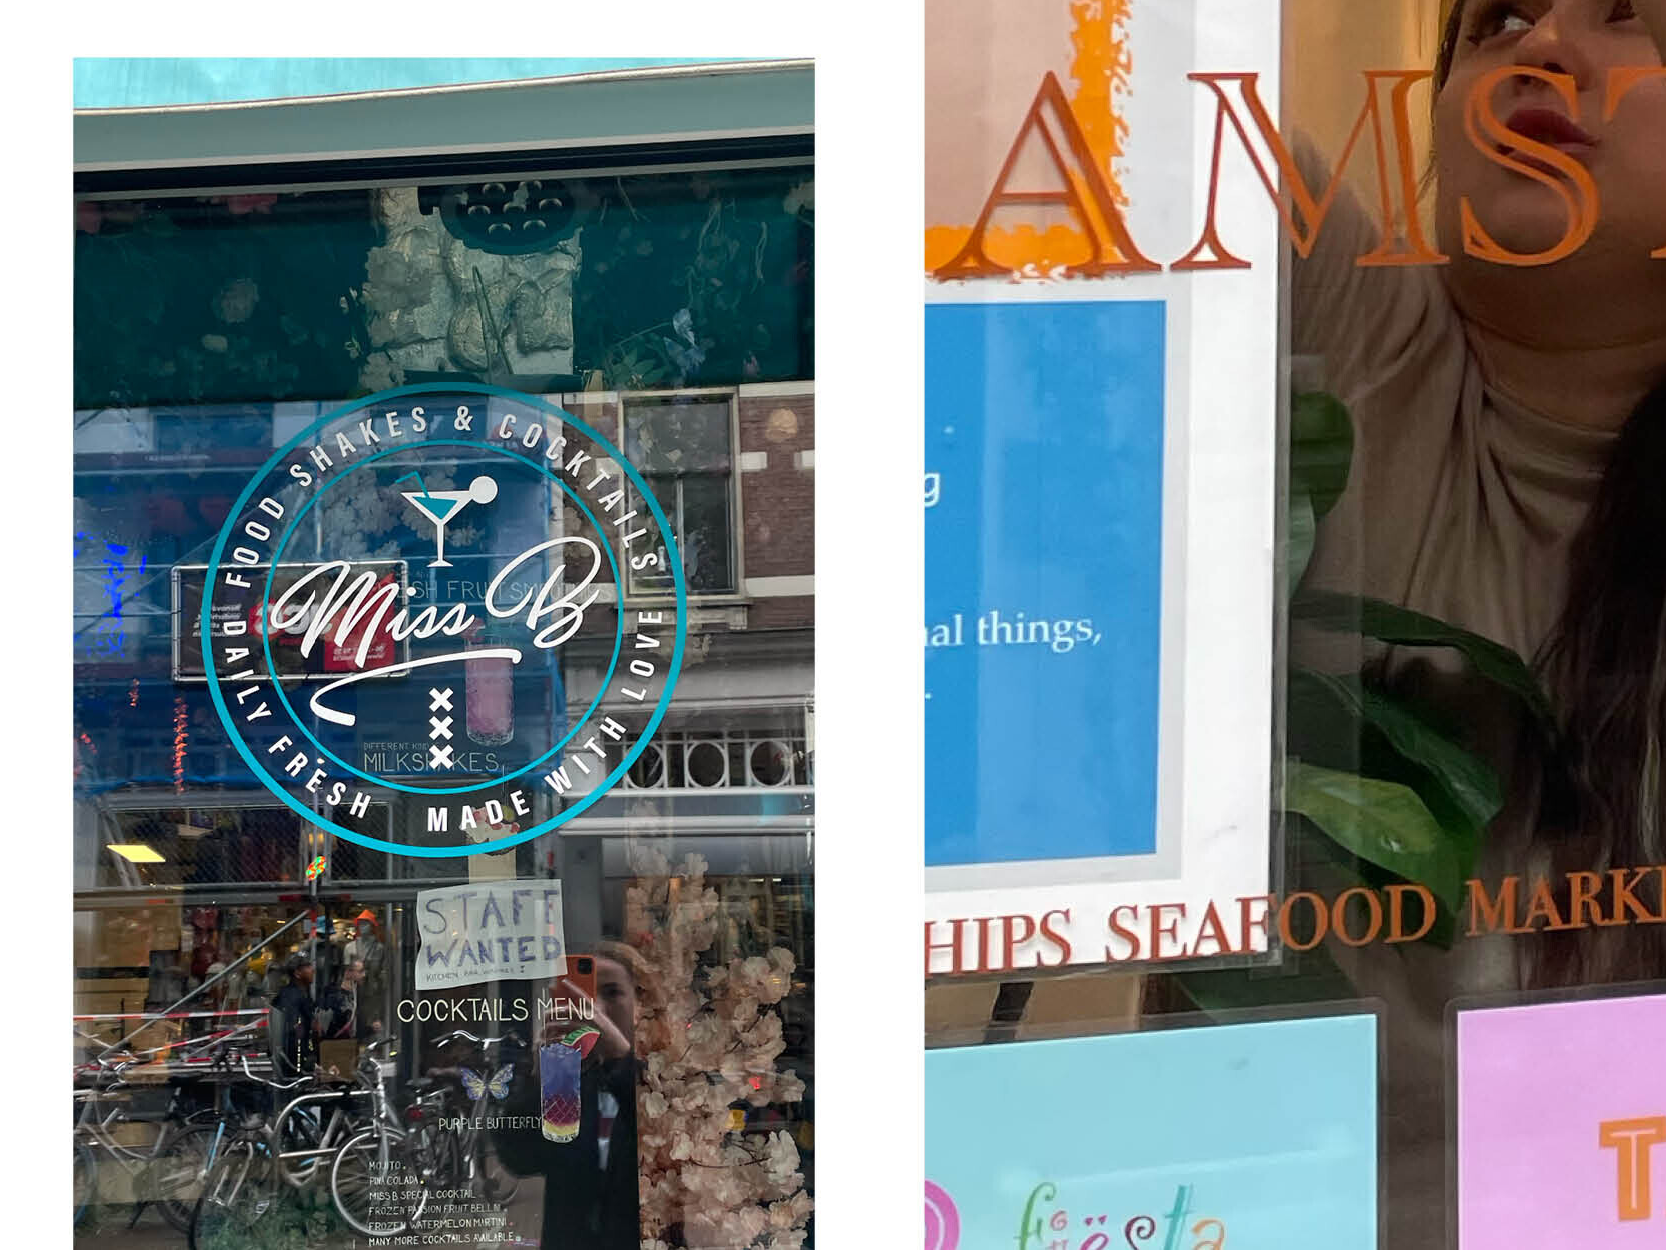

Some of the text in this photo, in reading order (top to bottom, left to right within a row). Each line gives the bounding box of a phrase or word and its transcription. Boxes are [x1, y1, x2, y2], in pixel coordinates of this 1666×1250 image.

[225, 405, 658, 589] FOOD SHAKES & COCKTAILS
[271, 536, 601, 668] Miss B
[977, 610, 1102, 654] things,
[223, 620, 272, 722] DAILY
[268, 734, 372, 819] FRESH
[427, 790, 530, 832] MADE
[543, 716, 627, 795] WITH
[621, 611, 663, 701] LOVE
[364, 752, 500, 773] MILKSKES
[423, 889, 560, 935] STAFF
[925, 906, 1071, 979] HIPS
[1105, 883, 1437, 963] SEAFOOD
[425, 936, 562, 968] WANTED
[397, 997, 595, 1023] COCKTAILS MENU
[438, 1116, 542, 1131] PURPLE BUTTERFLY
[369, 1191, 391, 1201] MISS
[400, 1190, 435, 1200] SPECL
[436, 1189, 477, 1199] COCKTAIL
[368, 1236, 392, 1247] MANY
[394, 1235, 420, 1246] MORE
[422, 1234, 471, 1245] COCKTAILS
